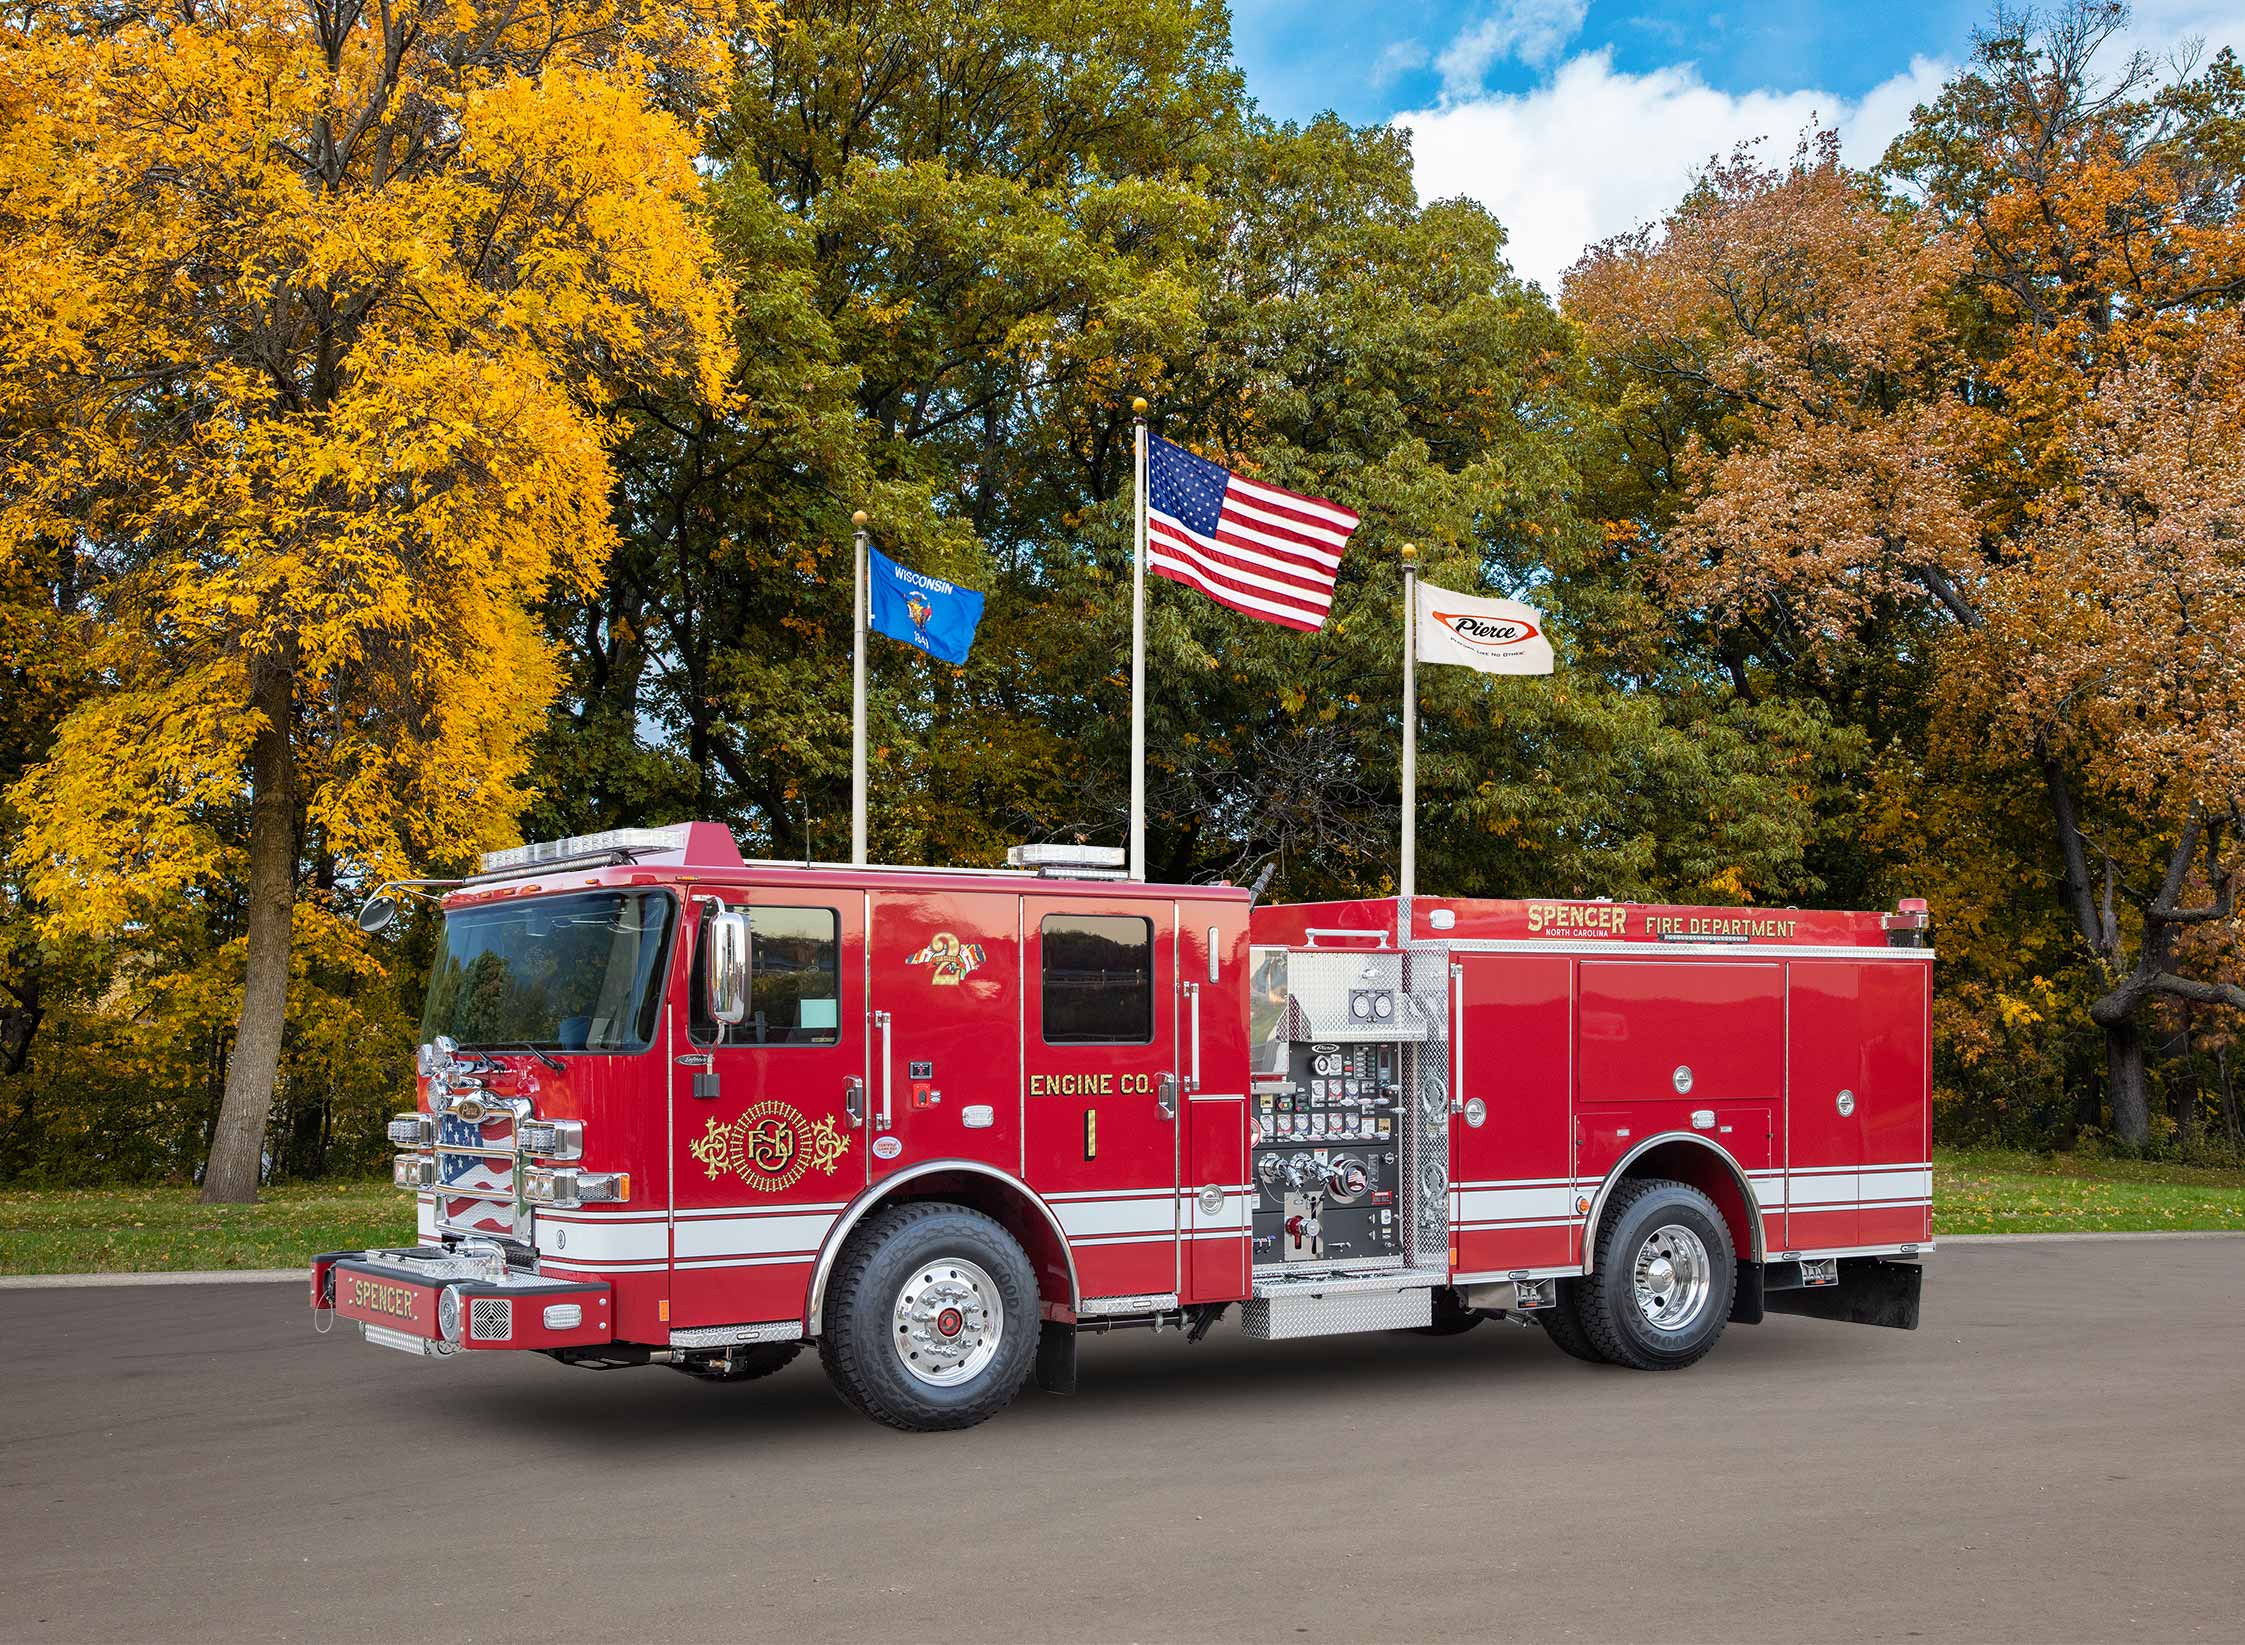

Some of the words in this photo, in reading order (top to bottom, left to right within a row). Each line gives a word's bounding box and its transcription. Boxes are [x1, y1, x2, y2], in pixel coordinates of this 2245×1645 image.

[895, 566, 953, 595] WISCONSIN
[1455, 618, 1516, 639] Pierce
[1528, 904, 1627, 935] SPENCER
[1646, 916, 1681, 935] FIRE
[1690, 918, 1797, 938] DEPARTMENT
[1545, 928, 1571, 937] NORTH
[1573, 928, 1608, 938] CAROLINA
[931, 932, 960, 986] 2
[1029, 1073, 1113, 1096] ENGINE
[1120, 1073, 1154, 1096] CO.
[355, 1279, 413, 1320] SPENCER
